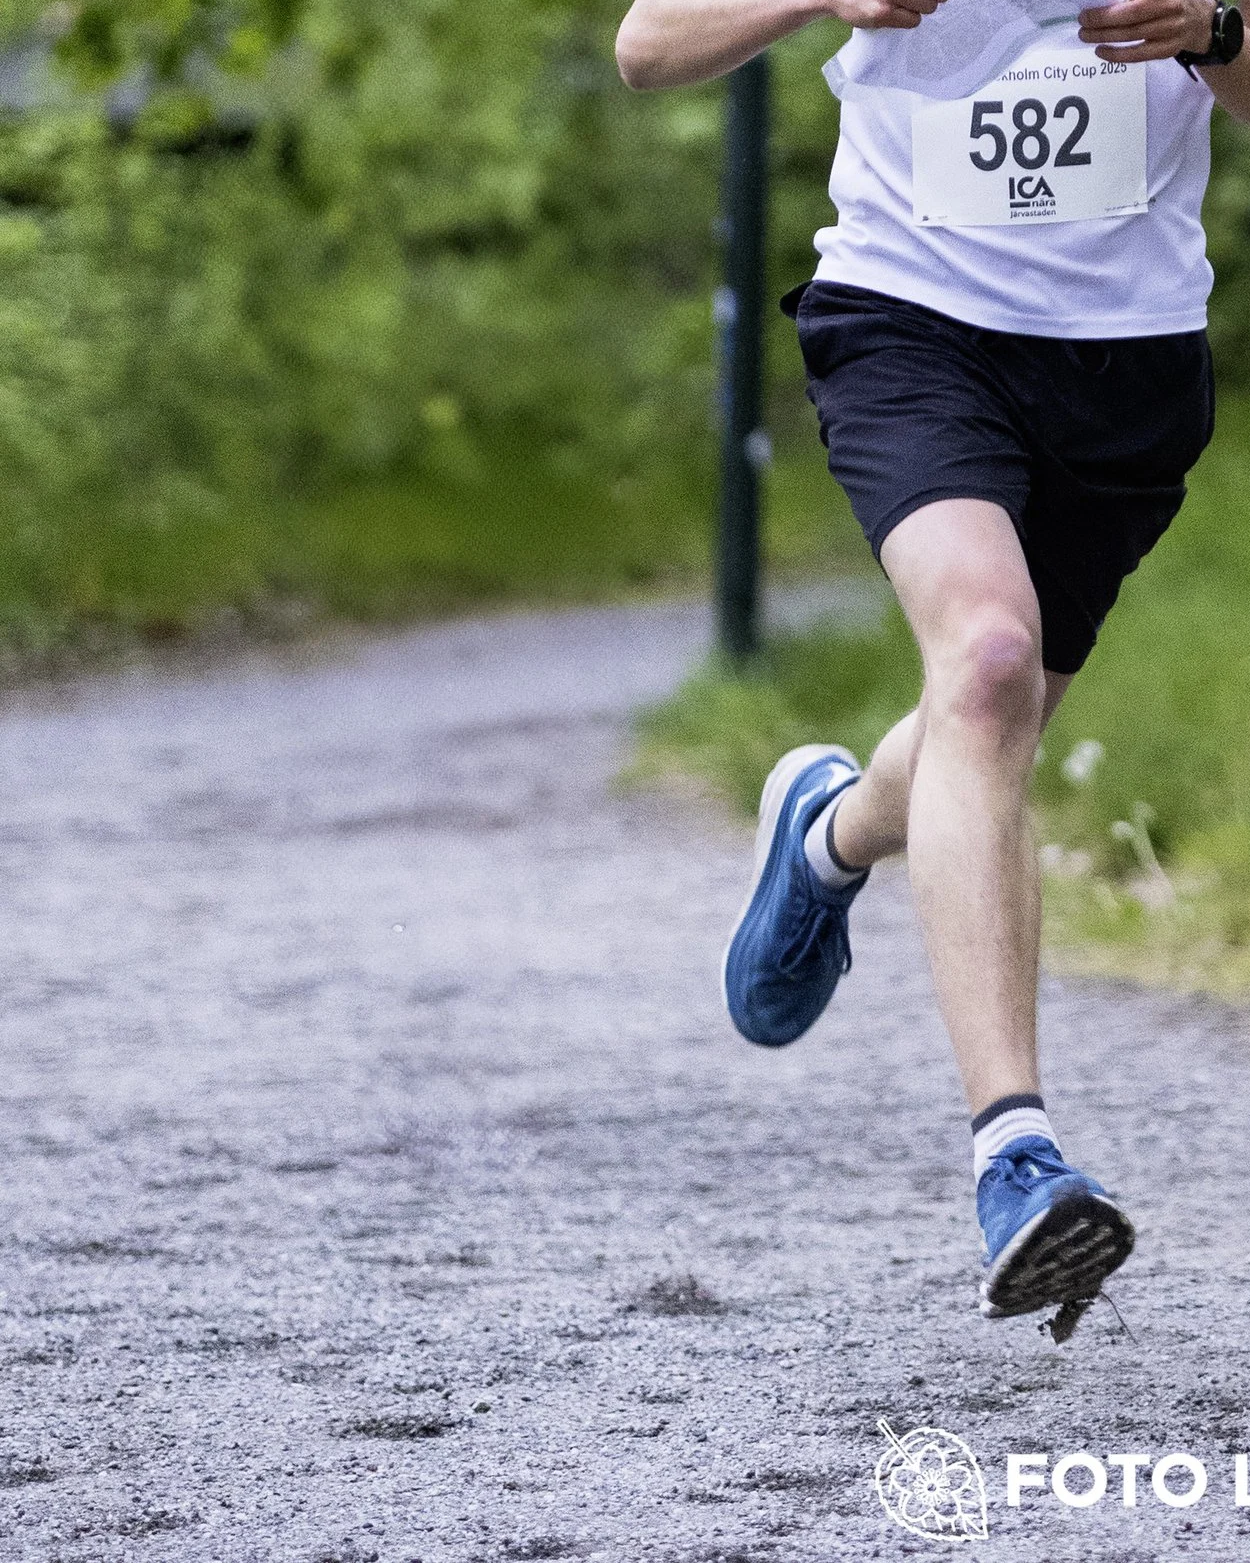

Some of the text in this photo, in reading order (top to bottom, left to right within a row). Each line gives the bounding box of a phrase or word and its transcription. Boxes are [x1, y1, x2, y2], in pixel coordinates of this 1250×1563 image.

[1044, 66, 1068, 81] City
[1073, 64, 1097, 79] Cup
[1100, 61, 1127, 75] 2025
[969, 95, 1092, 171] 582
[1009, 175, 1055, 199] ICA
[1032, 198, 1056, 207] nära
